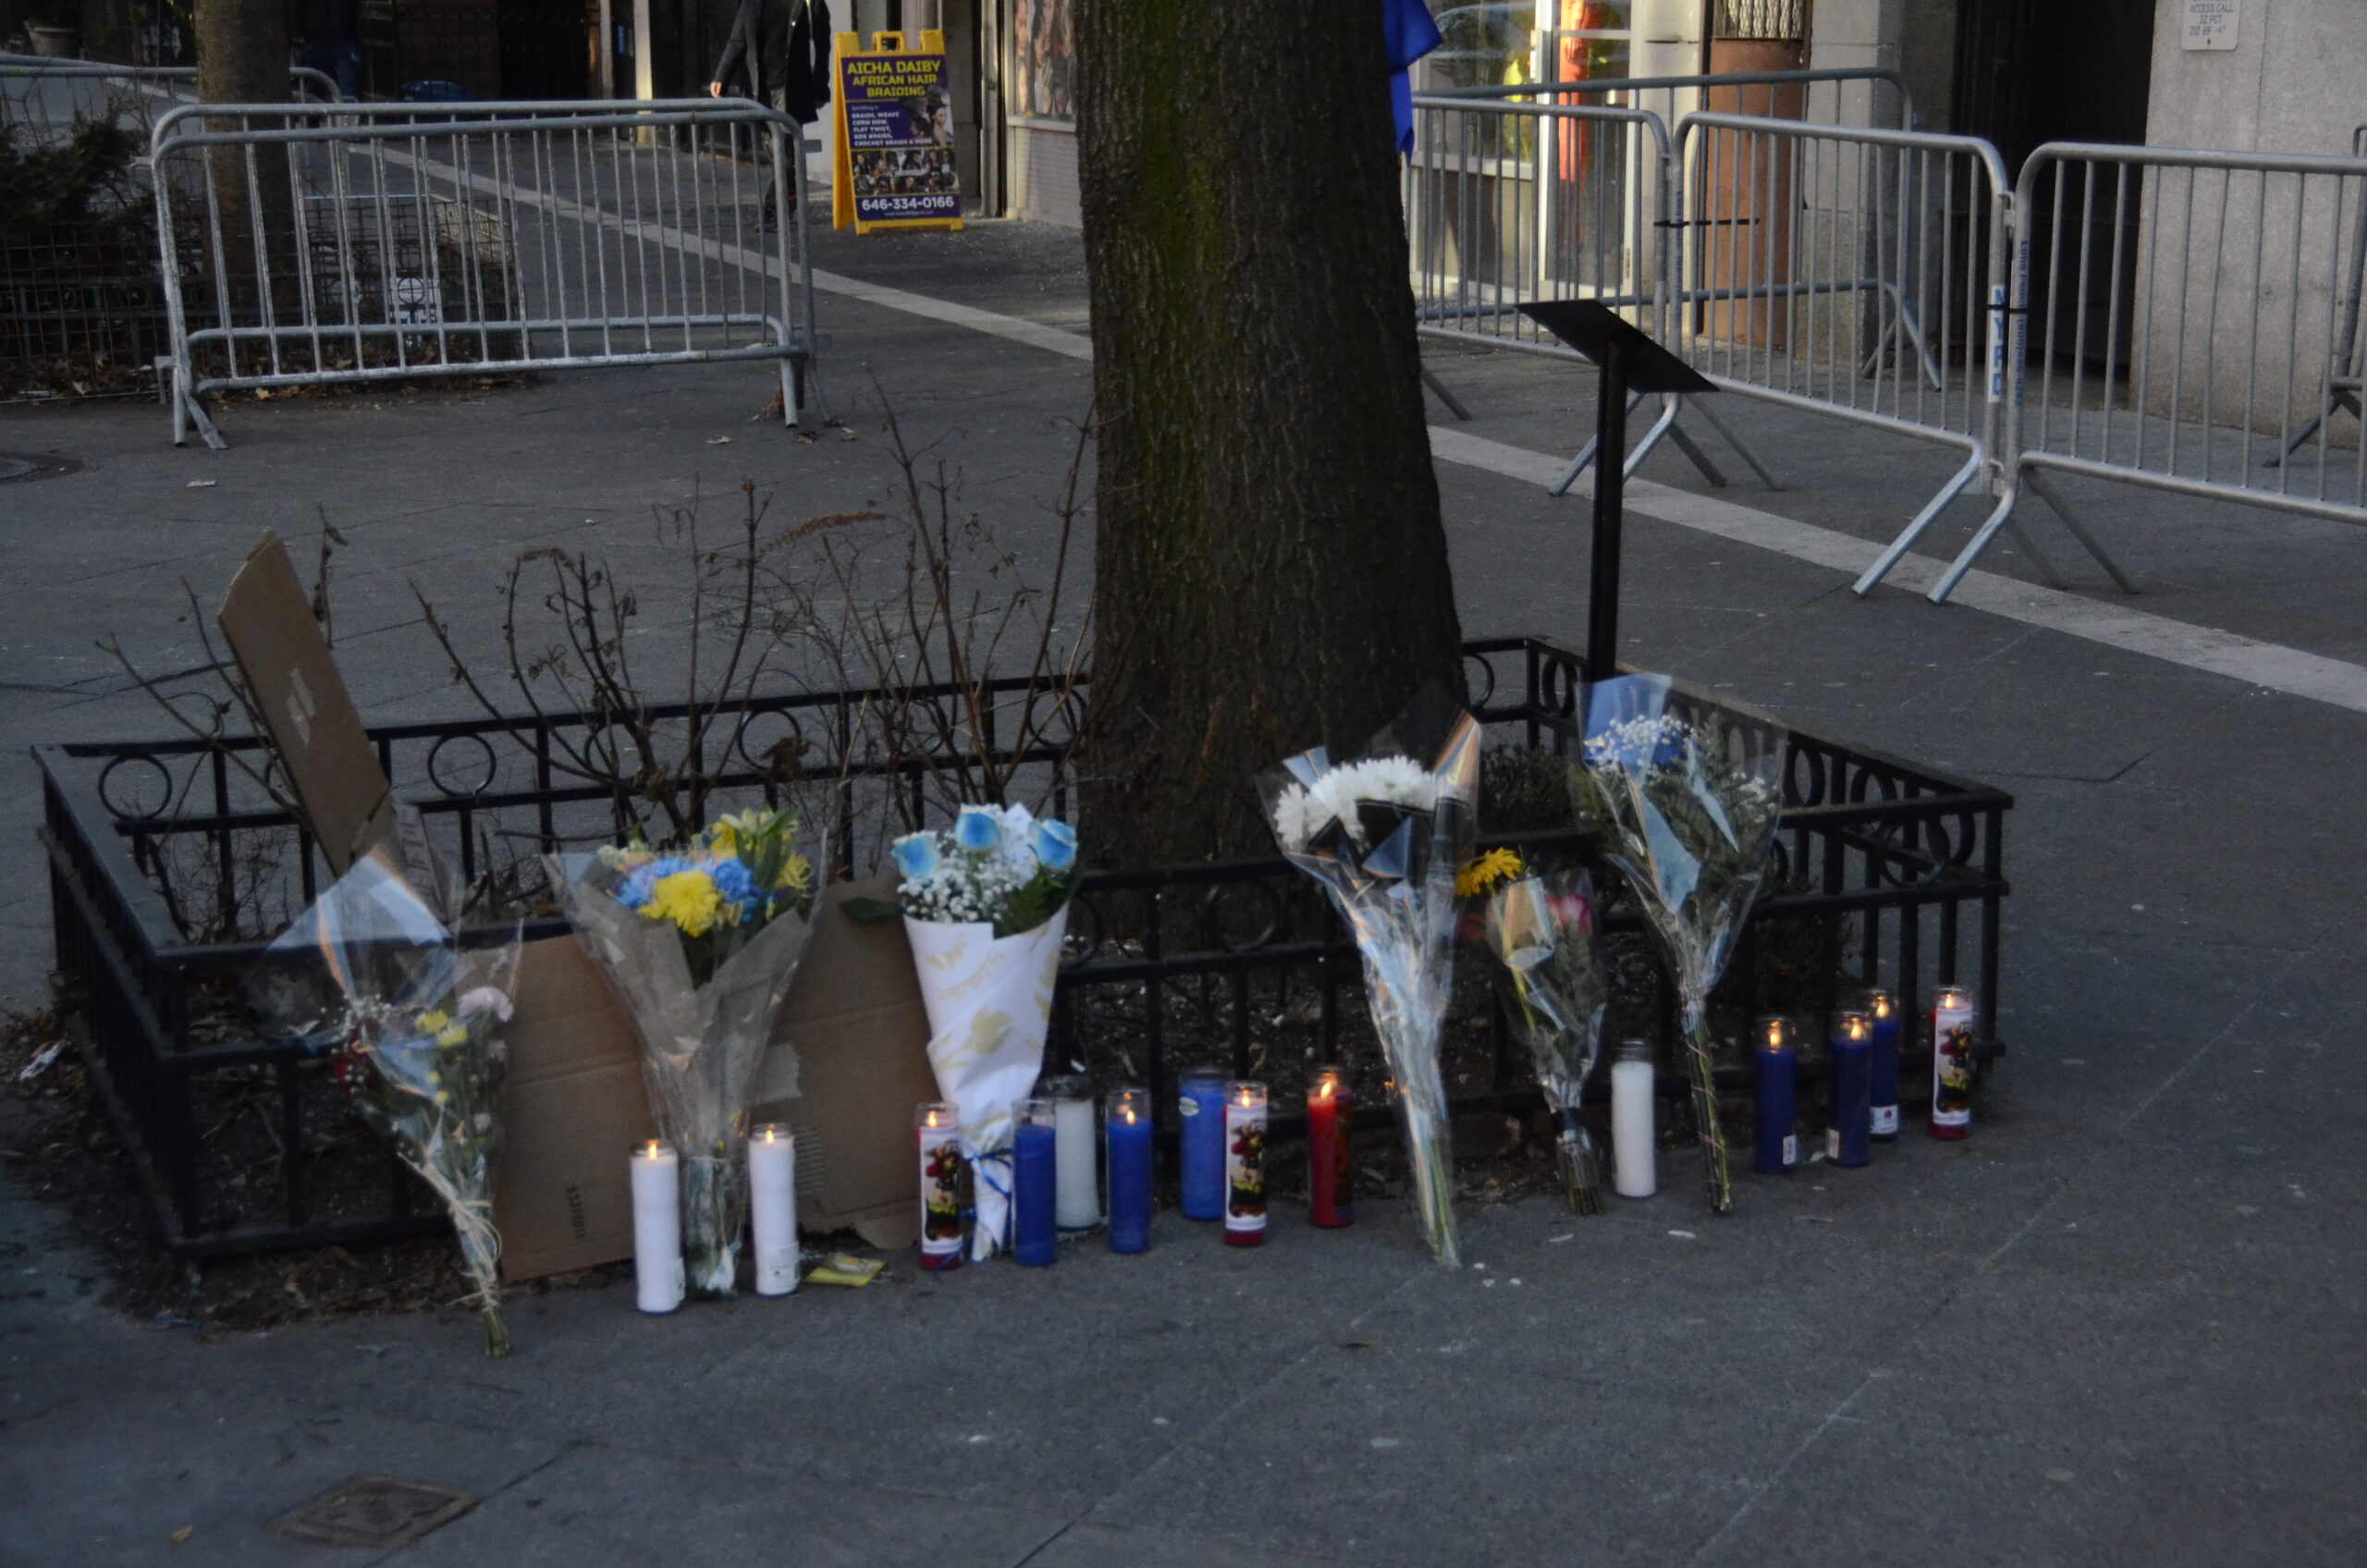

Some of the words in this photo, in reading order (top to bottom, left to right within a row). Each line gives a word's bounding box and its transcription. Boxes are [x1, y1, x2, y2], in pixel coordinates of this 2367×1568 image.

[2189, 3, 2214, 13] ACCESS
[2216, 3, 2234, 13] CALL
[847, 61, 893, 74] AICHA
[897, 59, 940, 73] DAIBY
[852, 75, 904, 86] AFRICAN
[907, 73, 938, 84] HAIR
[866, 86, 926, 98] BRAIDING
[861, 195, 954, 211] 646-334-0166
[2018, 240, 2029, 270] Long
